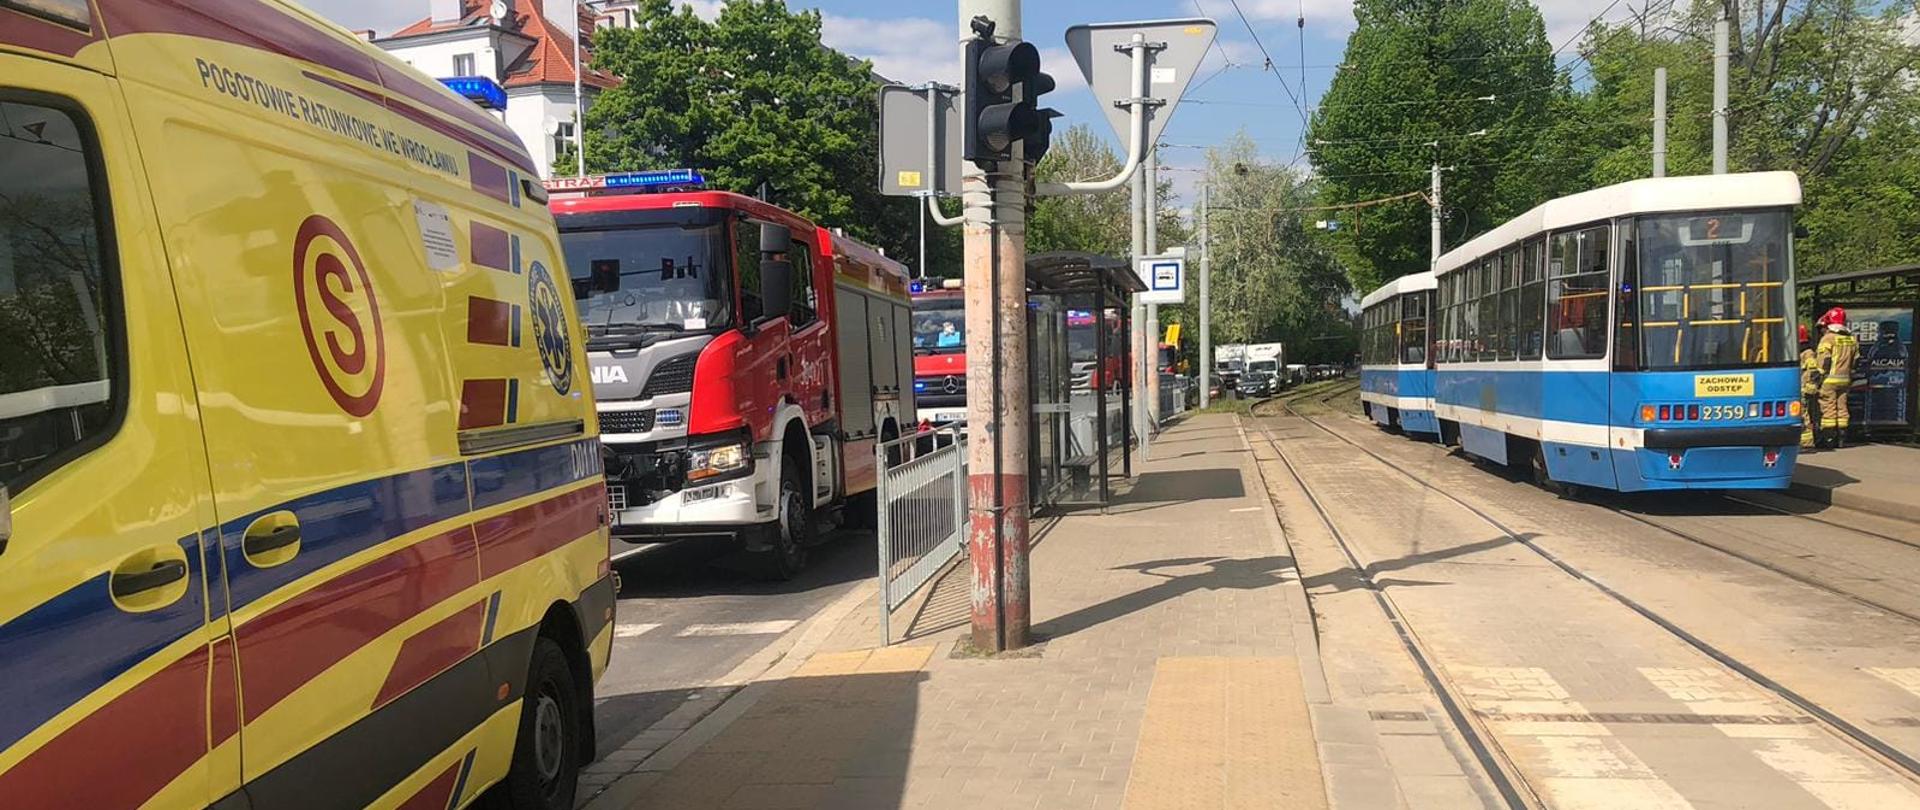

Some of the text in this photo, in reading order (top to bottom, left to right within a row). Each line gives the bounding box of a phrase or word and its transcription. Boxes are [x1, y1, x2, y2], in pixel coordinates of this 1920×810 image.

[195, 57, 459, 176] POGOTOWIE RATUNKOWE WE WROCŁAWIU
[1706, 218, 1720, 240] 2
[315, 252, 366, 376] S
[1699, 376, 1750, 385] ZACHOWAJ
[1706, 385, 1743, 393] ODSTĘP
[1702, 405, 1745, 420] 2359
